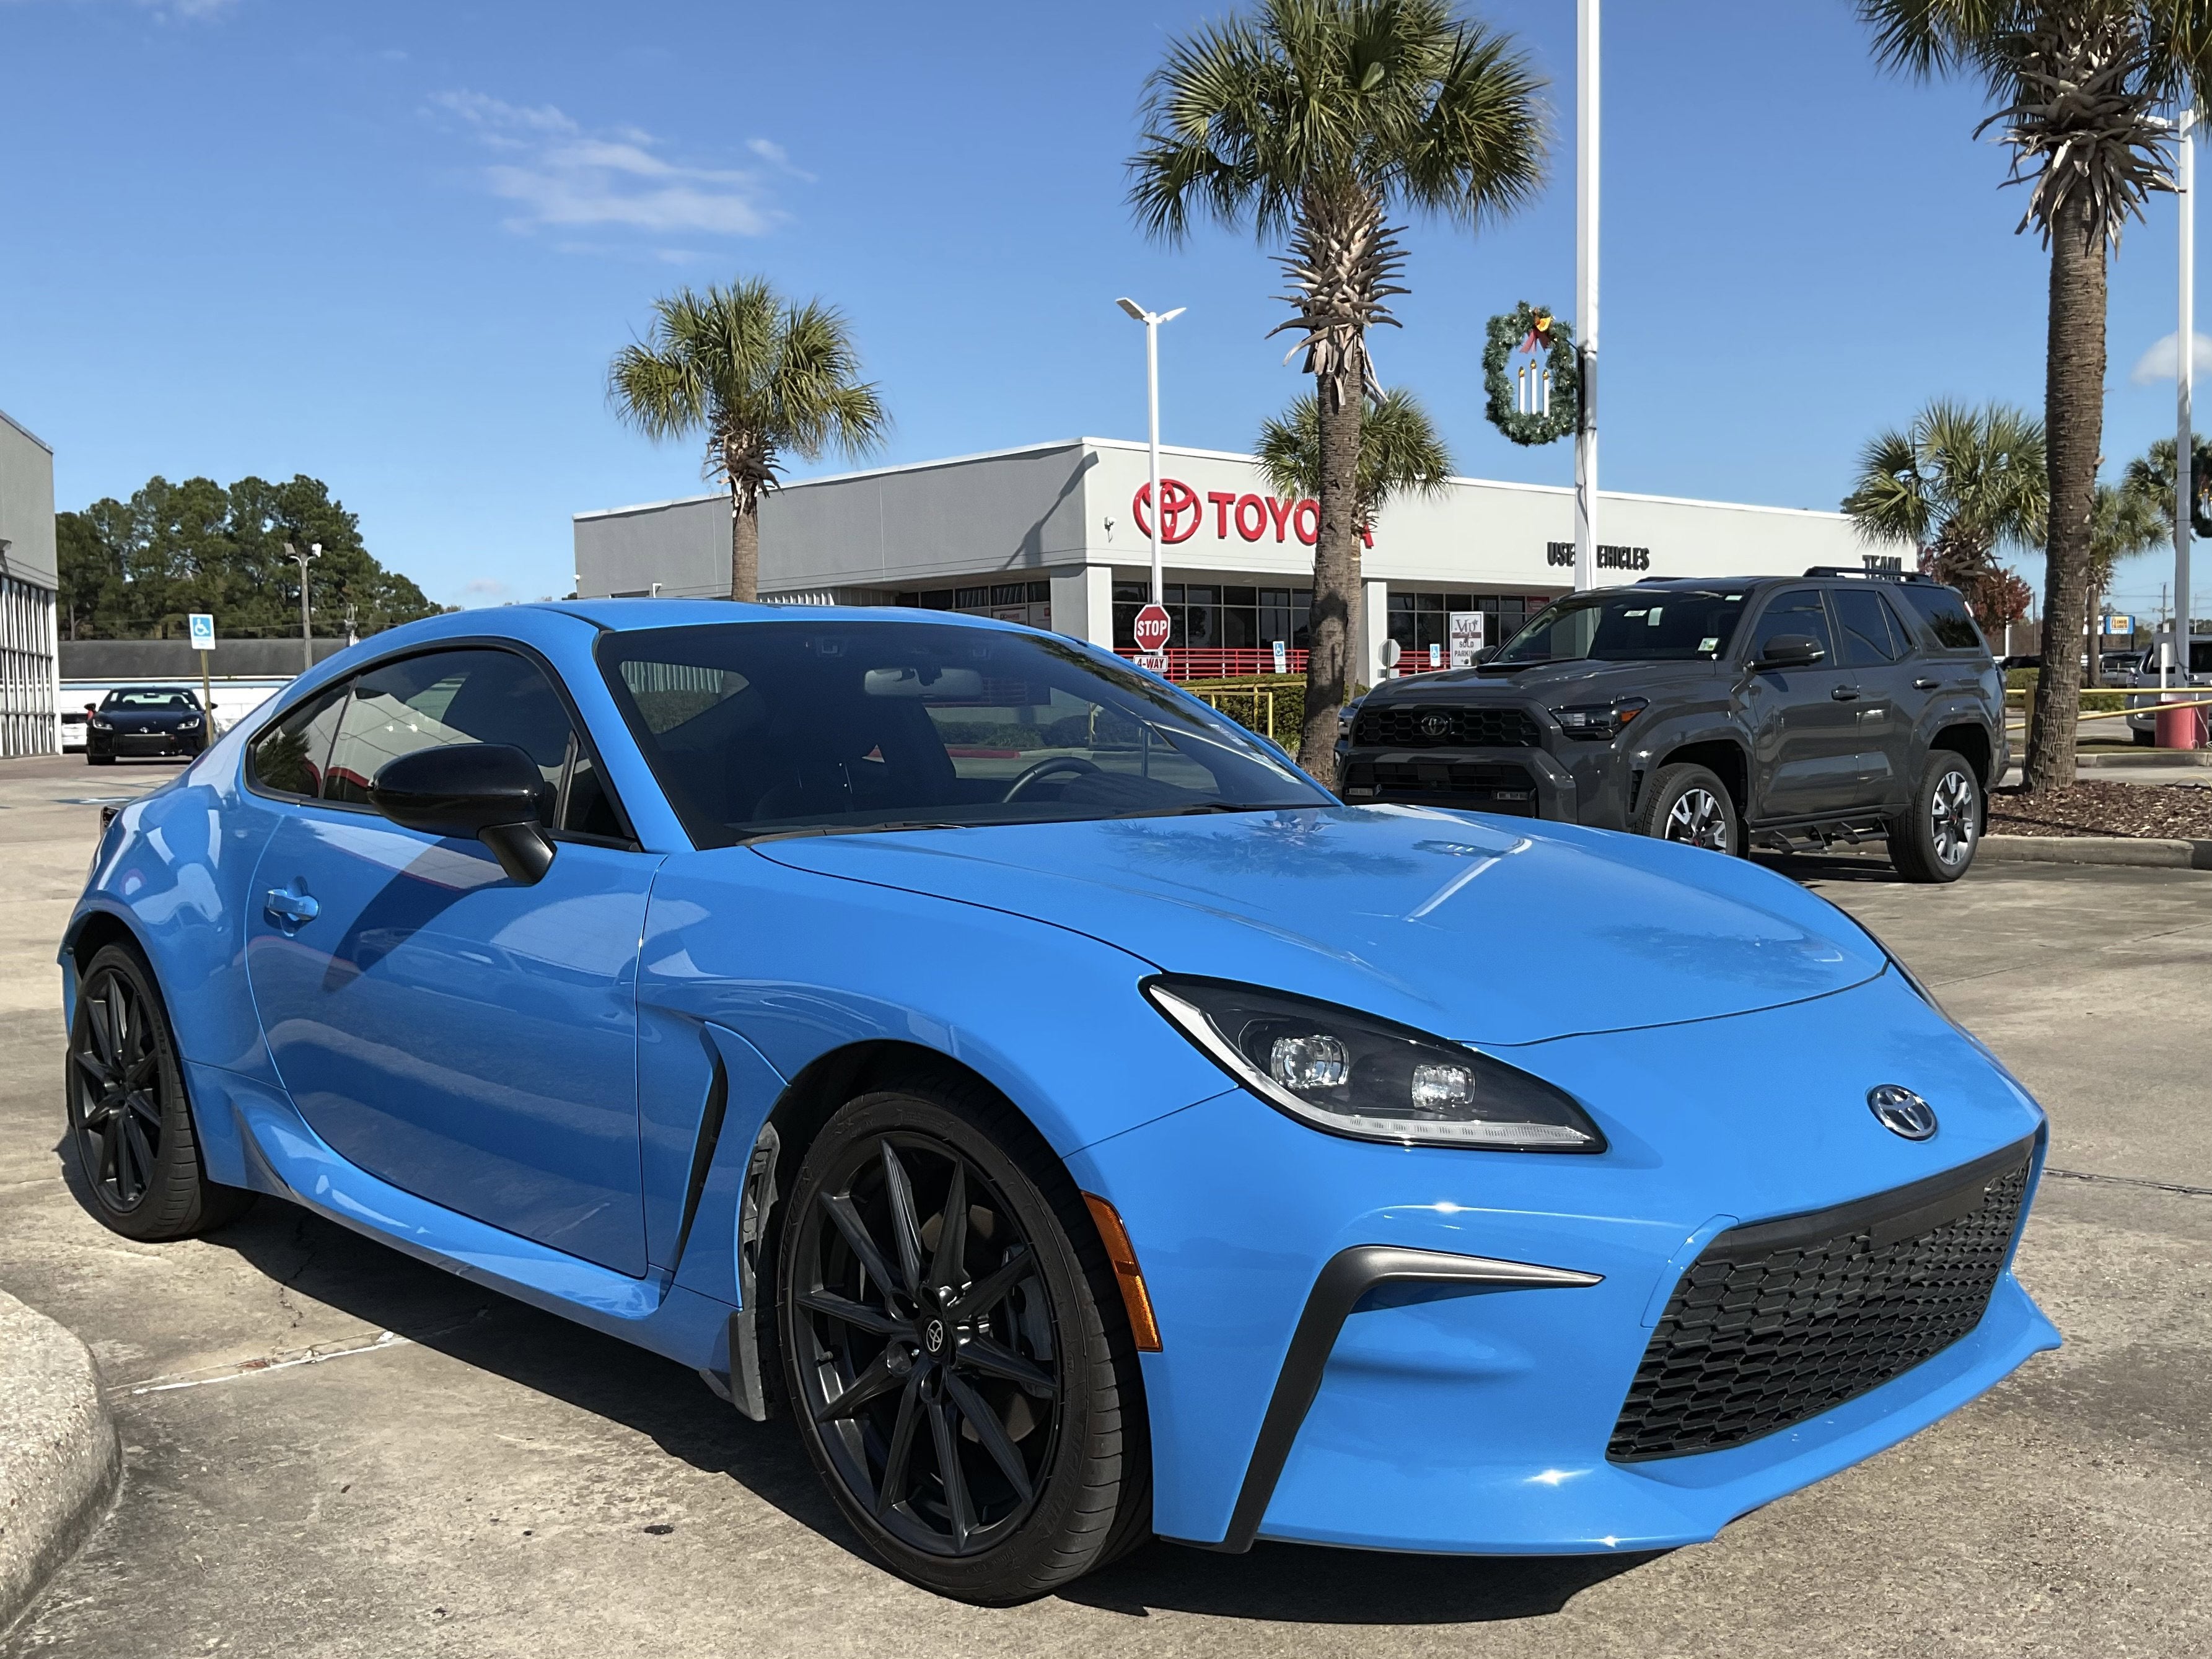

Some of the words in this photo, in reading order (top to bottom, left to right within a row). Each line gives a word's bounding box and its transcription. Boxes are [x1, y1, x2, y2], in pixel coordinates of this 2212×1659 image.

[1208, 491, 1374, 549] TOYO
[1547, 541, 1576, 567] USE
[1597, 545, 1649, 571] EHICLES
[1137, 620, 1167, 636] STOP
[1137, 658, 1164, 669] 4-WAY
